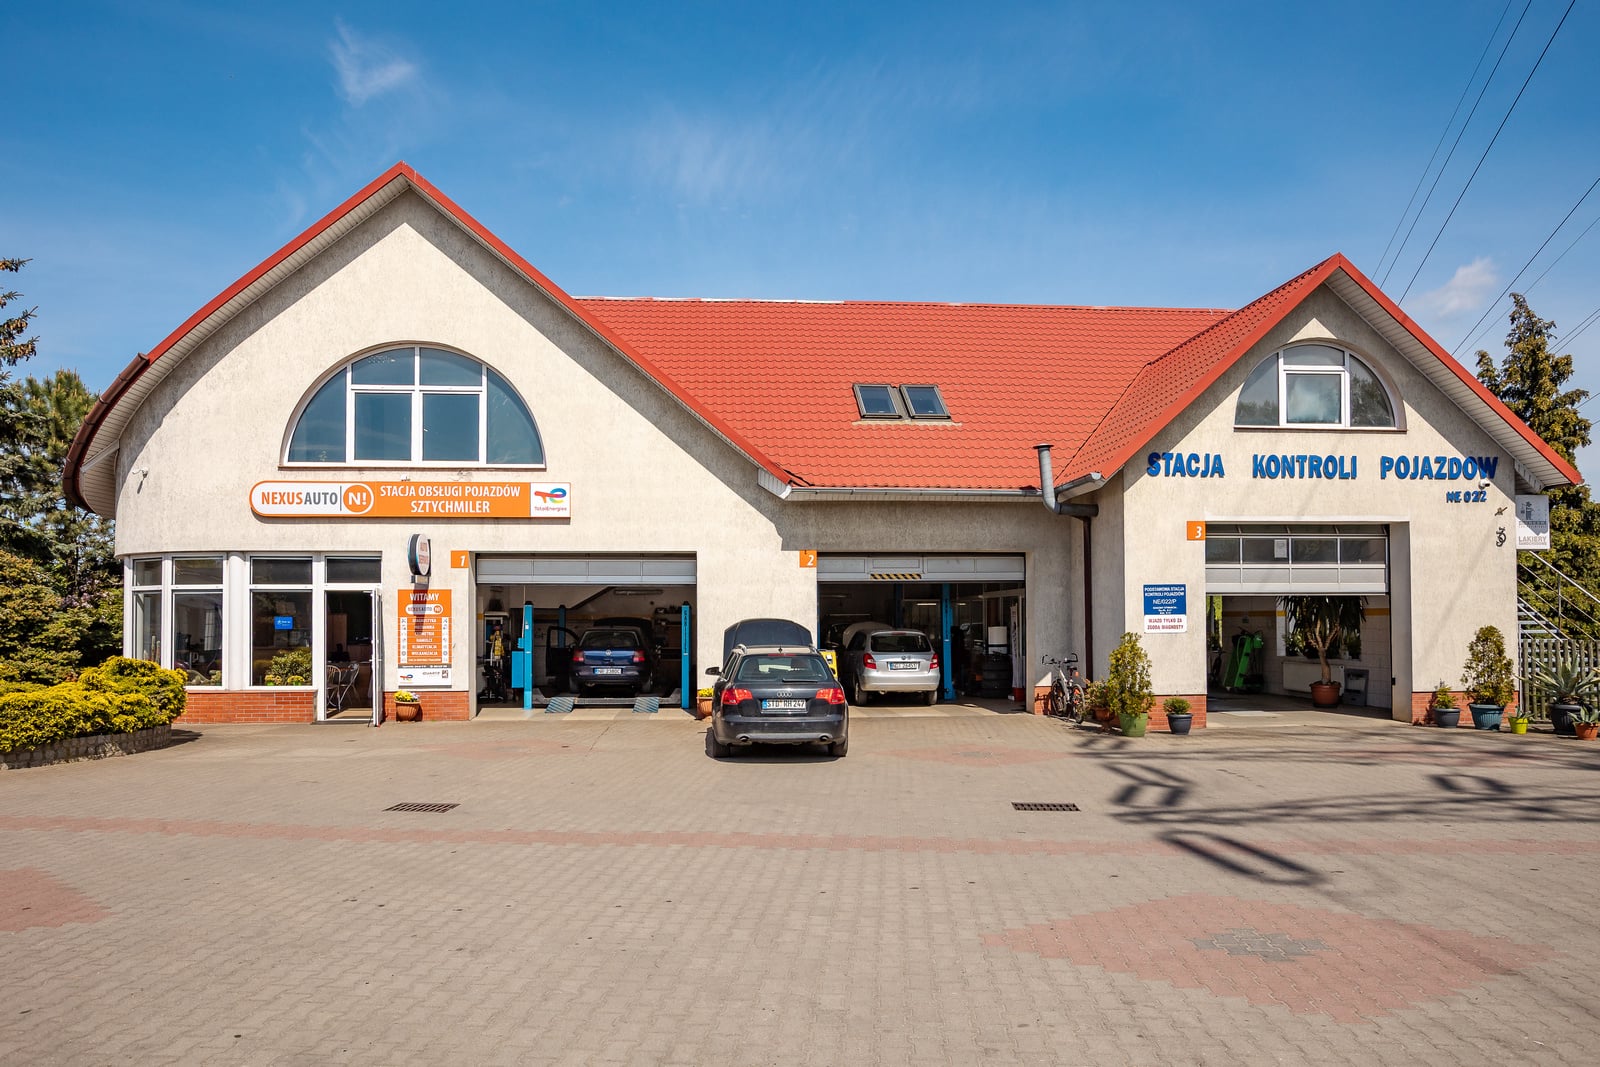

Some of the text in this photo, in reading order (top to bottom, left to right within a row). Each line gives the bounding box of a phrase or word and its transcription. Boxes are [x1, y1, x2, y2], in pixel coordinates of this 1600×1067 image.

[1147, 452, 1499, 480] STACJA KONTROLI POJAZDOW
[380, 484, 521, 497] STACJA OBSŁUGI POJAZDÓW
[1446, 490, 1487, 503] NE 022
[261, 491, 338, 505] NEXUSAUTO
[410, 501, 490, 513] SZTYCHMILER
[1195, 526, 1203, 539] 3
[460, 555, 466, 567] 1
[807, 554, 815, 566] 2
[410, 593, 440, 601] WITAMY
